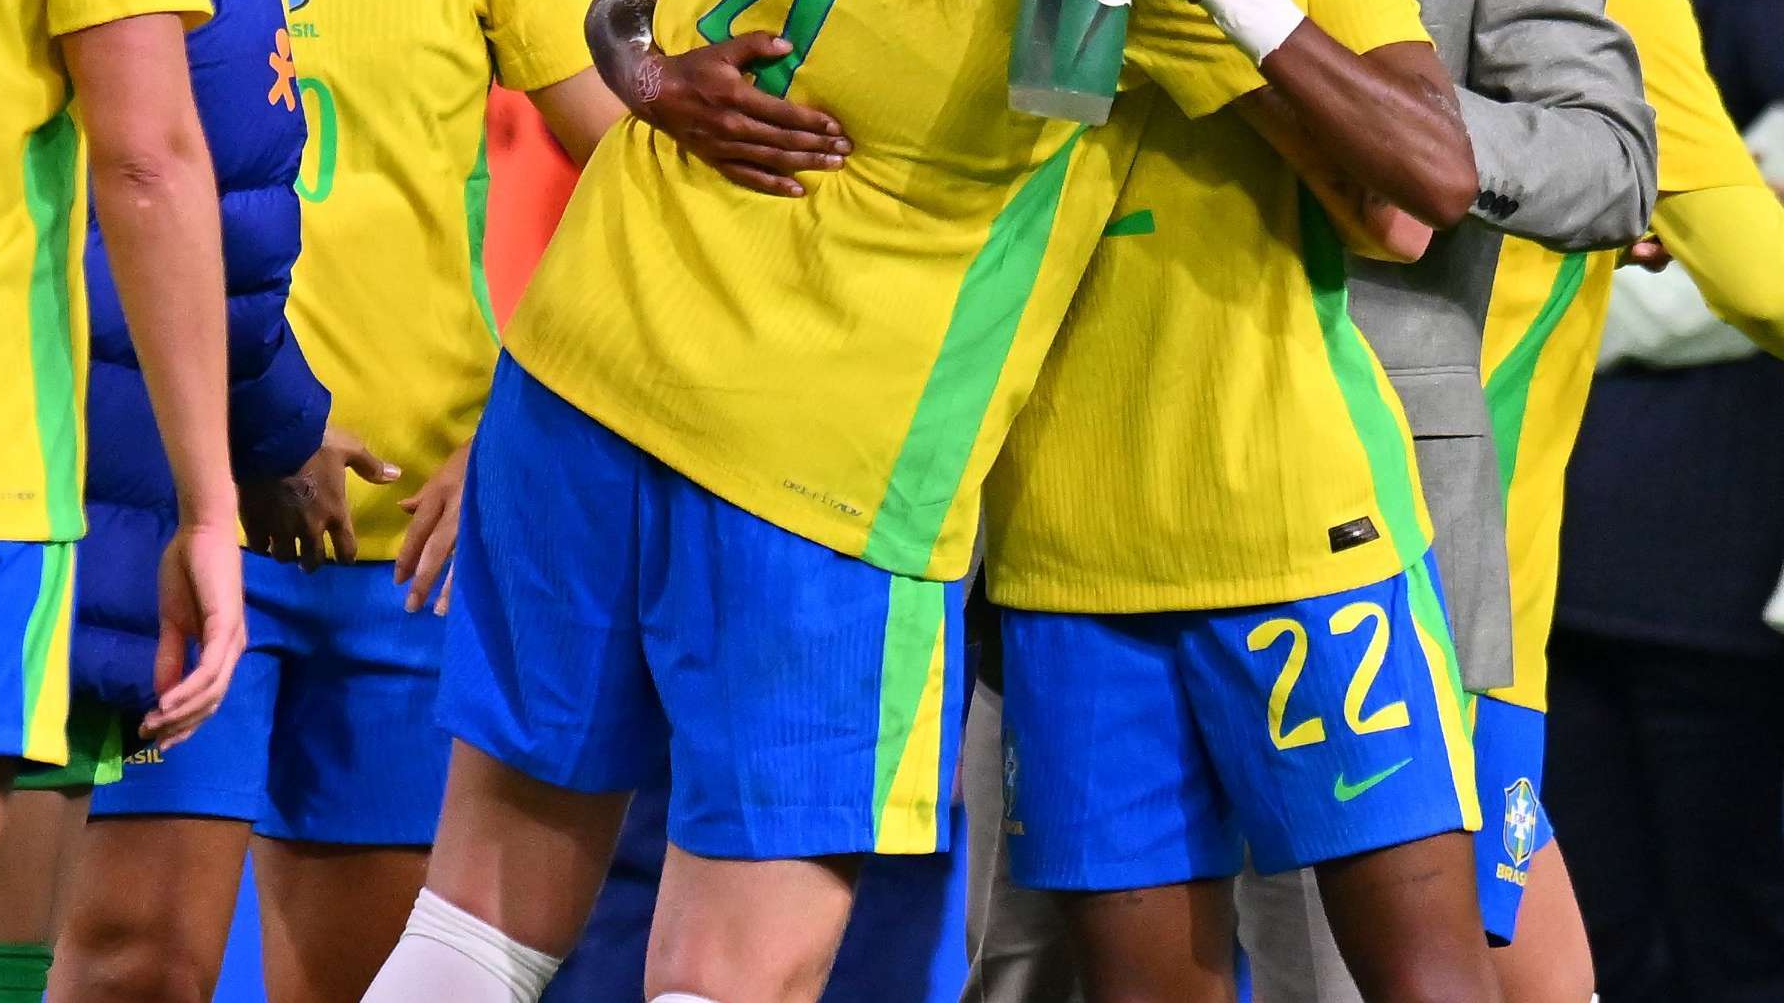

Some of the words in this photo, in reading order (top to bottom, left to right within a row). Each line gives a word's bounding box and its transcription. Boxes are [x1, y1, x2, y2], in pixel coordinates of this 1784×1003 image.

[290, 22, 320, 38] SIL
[293, 77, 338, 204] 0
[1247, 601, 1411, 751] 22
